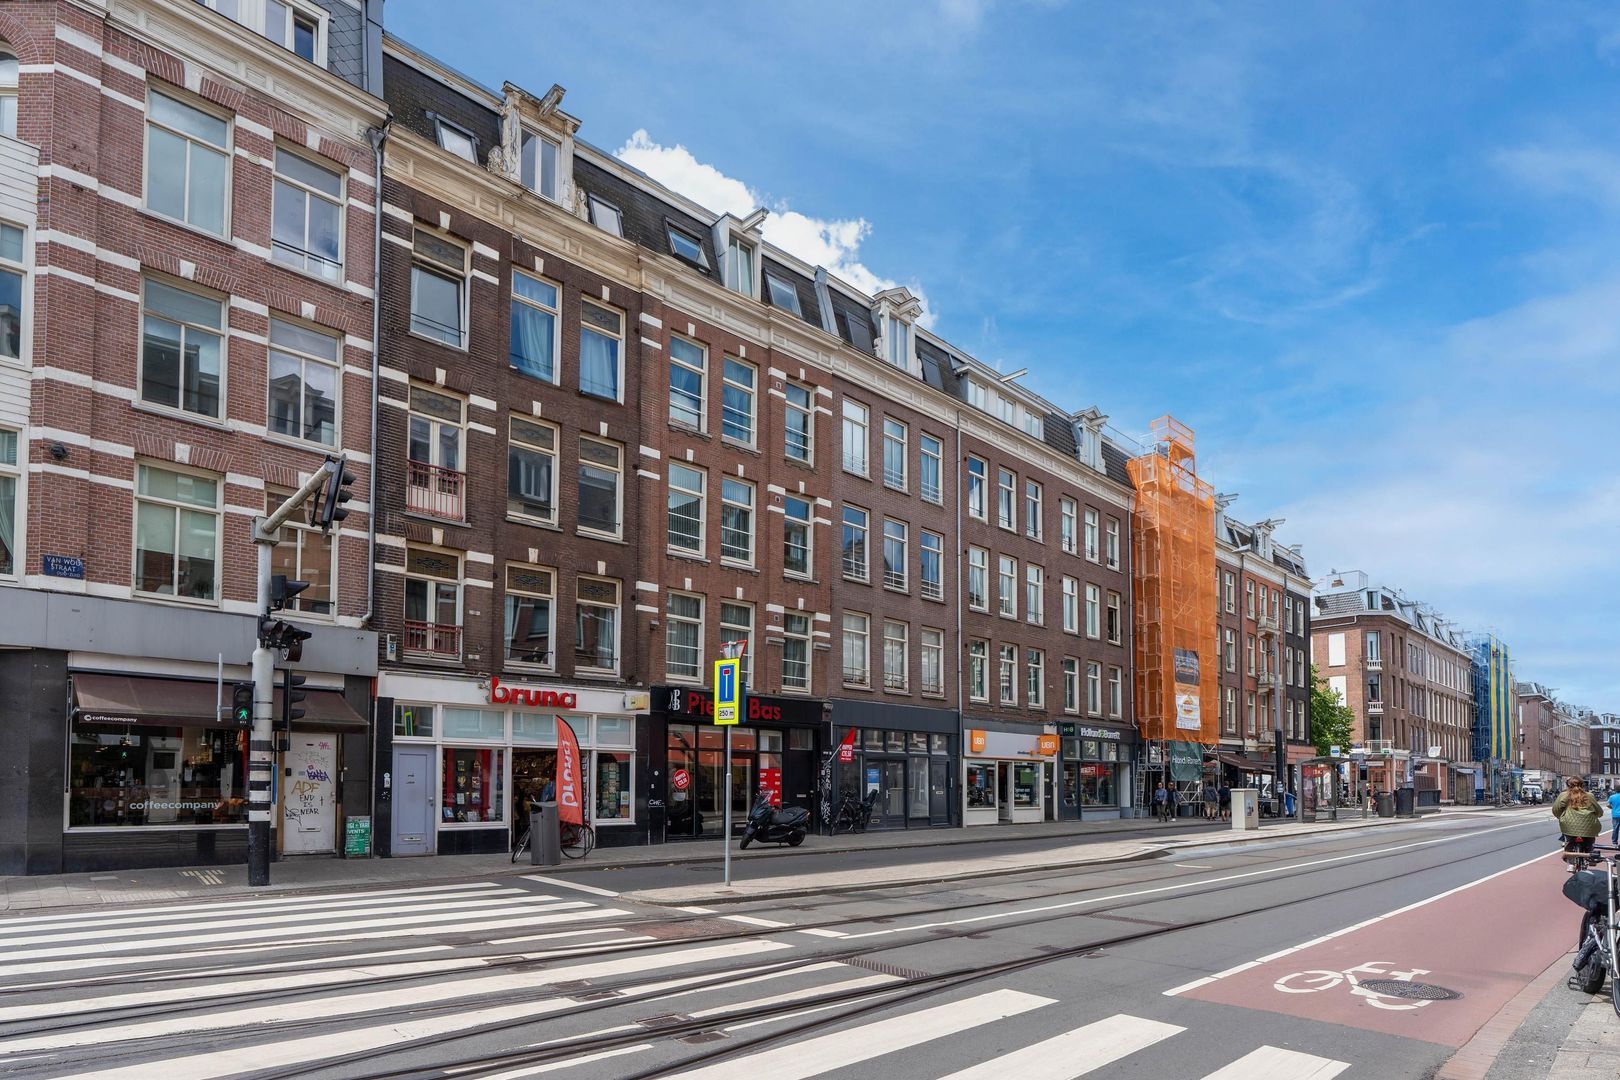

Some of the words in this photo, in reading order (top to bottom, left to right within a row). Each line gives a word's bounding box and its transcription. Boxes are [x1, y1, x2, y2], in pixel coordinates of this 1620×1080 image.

[50, 563, 76, 572] STRAAT
[491, 676, 576, 709] bruna
[687, 692, 714, 715] Pie
[749, 697, 782, 720] Bas
[92, 715, 138, 723] coffeecompany
[300, 794, 315, 802] END
[130, 800, 221, 810] coffeecompany
[300, 807, 320, 815] NEAR
